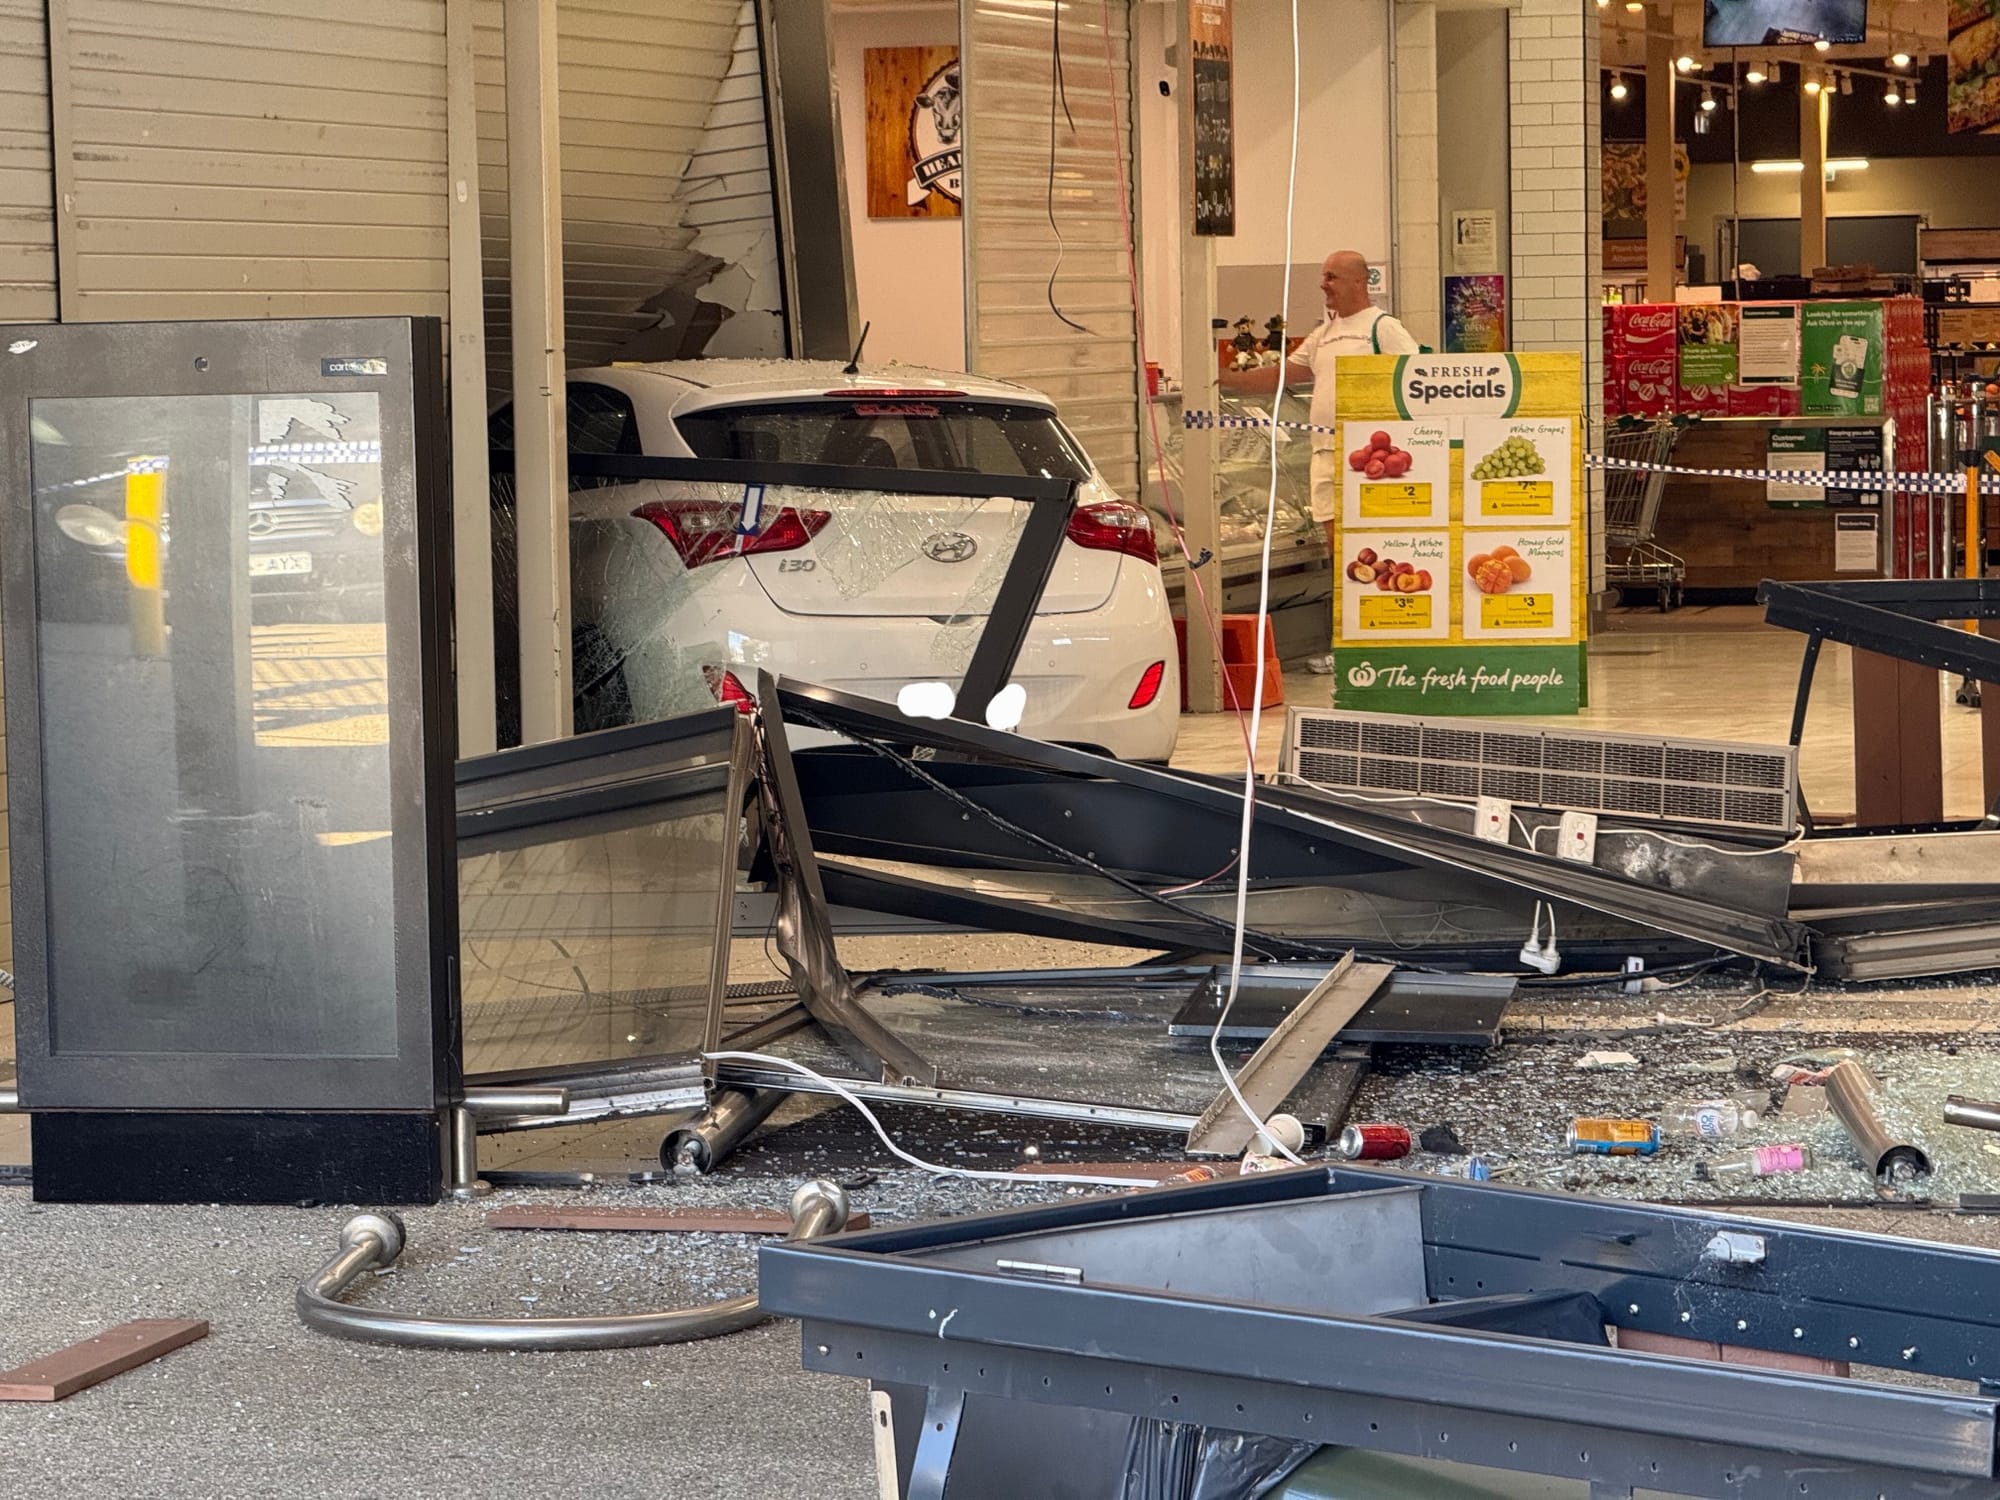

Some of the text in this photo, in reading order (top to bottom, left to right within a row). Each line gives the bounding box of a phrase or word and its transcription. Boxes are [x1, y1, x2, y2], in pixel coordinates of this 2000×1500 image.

[1806, 310, 1831, 319] Looking
[1431, 366, 1484, 378] FRESH
[1408, 379, 1506, 404] Specials
[1413, 426, 1443, 438] Cherry
[1510, 423, 1565, 435] White Grapes
[1407, 437, 1444, 447] Tomatoes
[1404, 486, 1416, 496] $2
[1383, 537, 1443, 549] Yellow & White
[1517, 536, 1565, 549] Honey Gold
[1412, 549, 1444, 559] Peaches
[1527, 547, 1564, 560] Mangoes
[779, 558, 817, 572] i30
[1523, 596, 1535, 607] $3
[1378, 664, 1563, 695] The fresh food people
